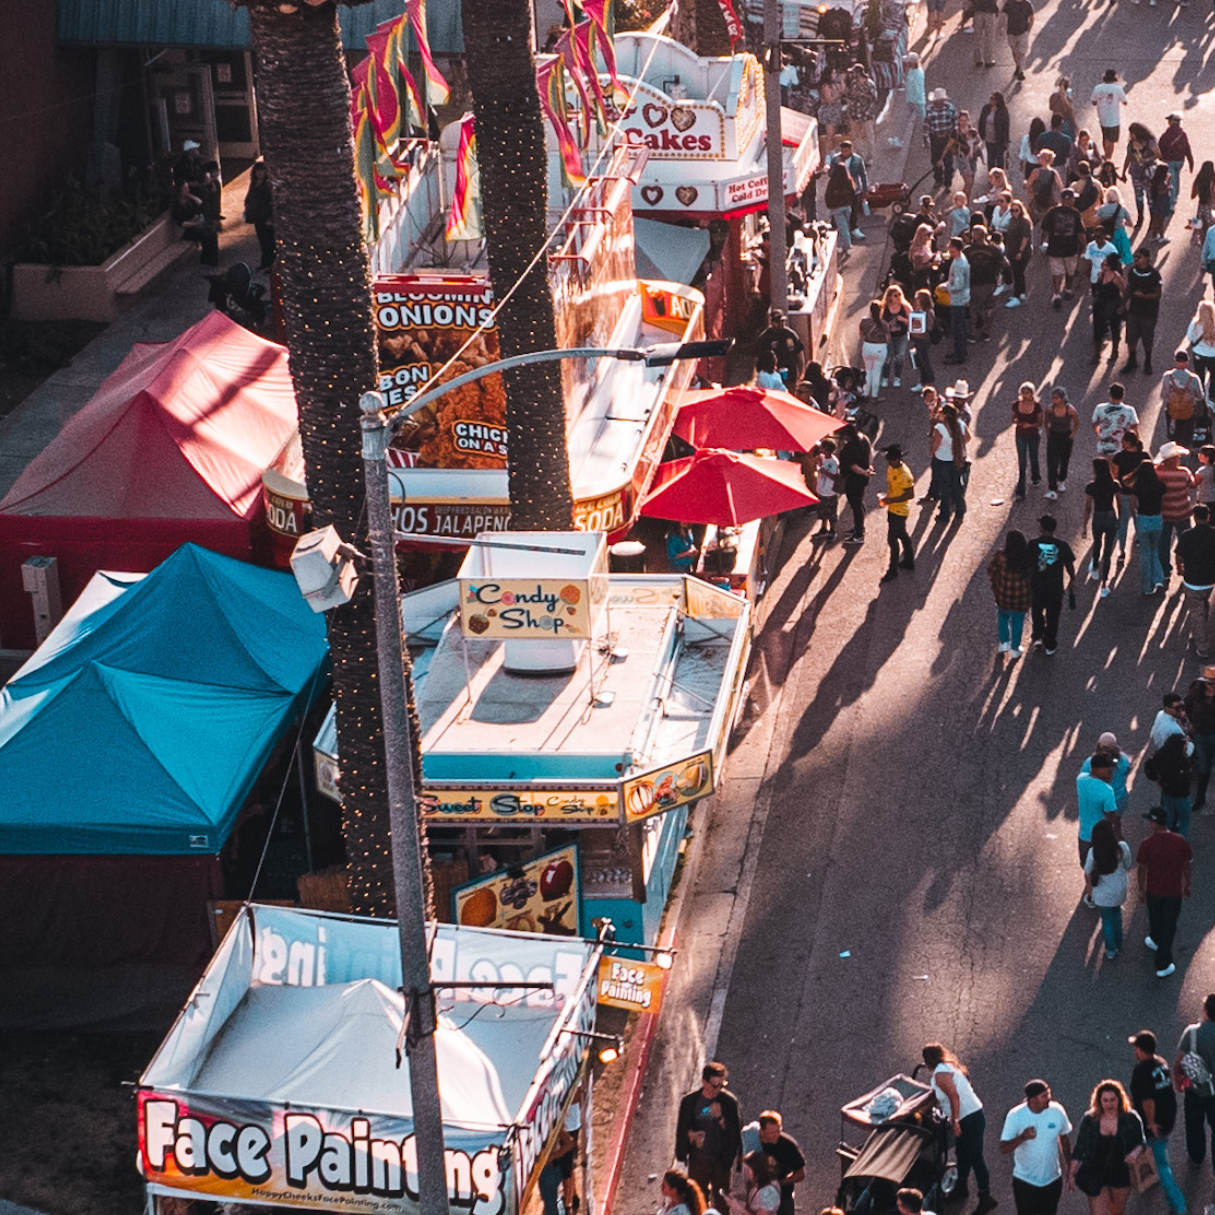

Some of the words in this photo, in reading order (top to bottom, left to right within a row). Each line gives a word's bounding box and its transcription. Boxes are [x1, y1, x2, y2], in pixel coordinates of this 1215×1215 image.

[625, 127, 712, 151] Cakes
[728, 182, 746, 194] Hot
[732, 188, 753, 202] Cold
[378, 304, 496, 329] ONIONS
[379, 365, 429, 391] BON
[458, 438, 481, 450] ON
[484, 439, 495, 452] A
[267, 504, 298, 533] ODA
[574, 503, 624, 533] SODA
[475, 584, 559, 612] Candy
[499, 608, 565, 634] Shop
[422, 794, 483, 815] Sweet
[492, 794, 545, 816] Stop
[611, 962, 645, 985] Face
[601, 980, 652, 1008] Painting
[145, 1099, 271, 1183] Face
